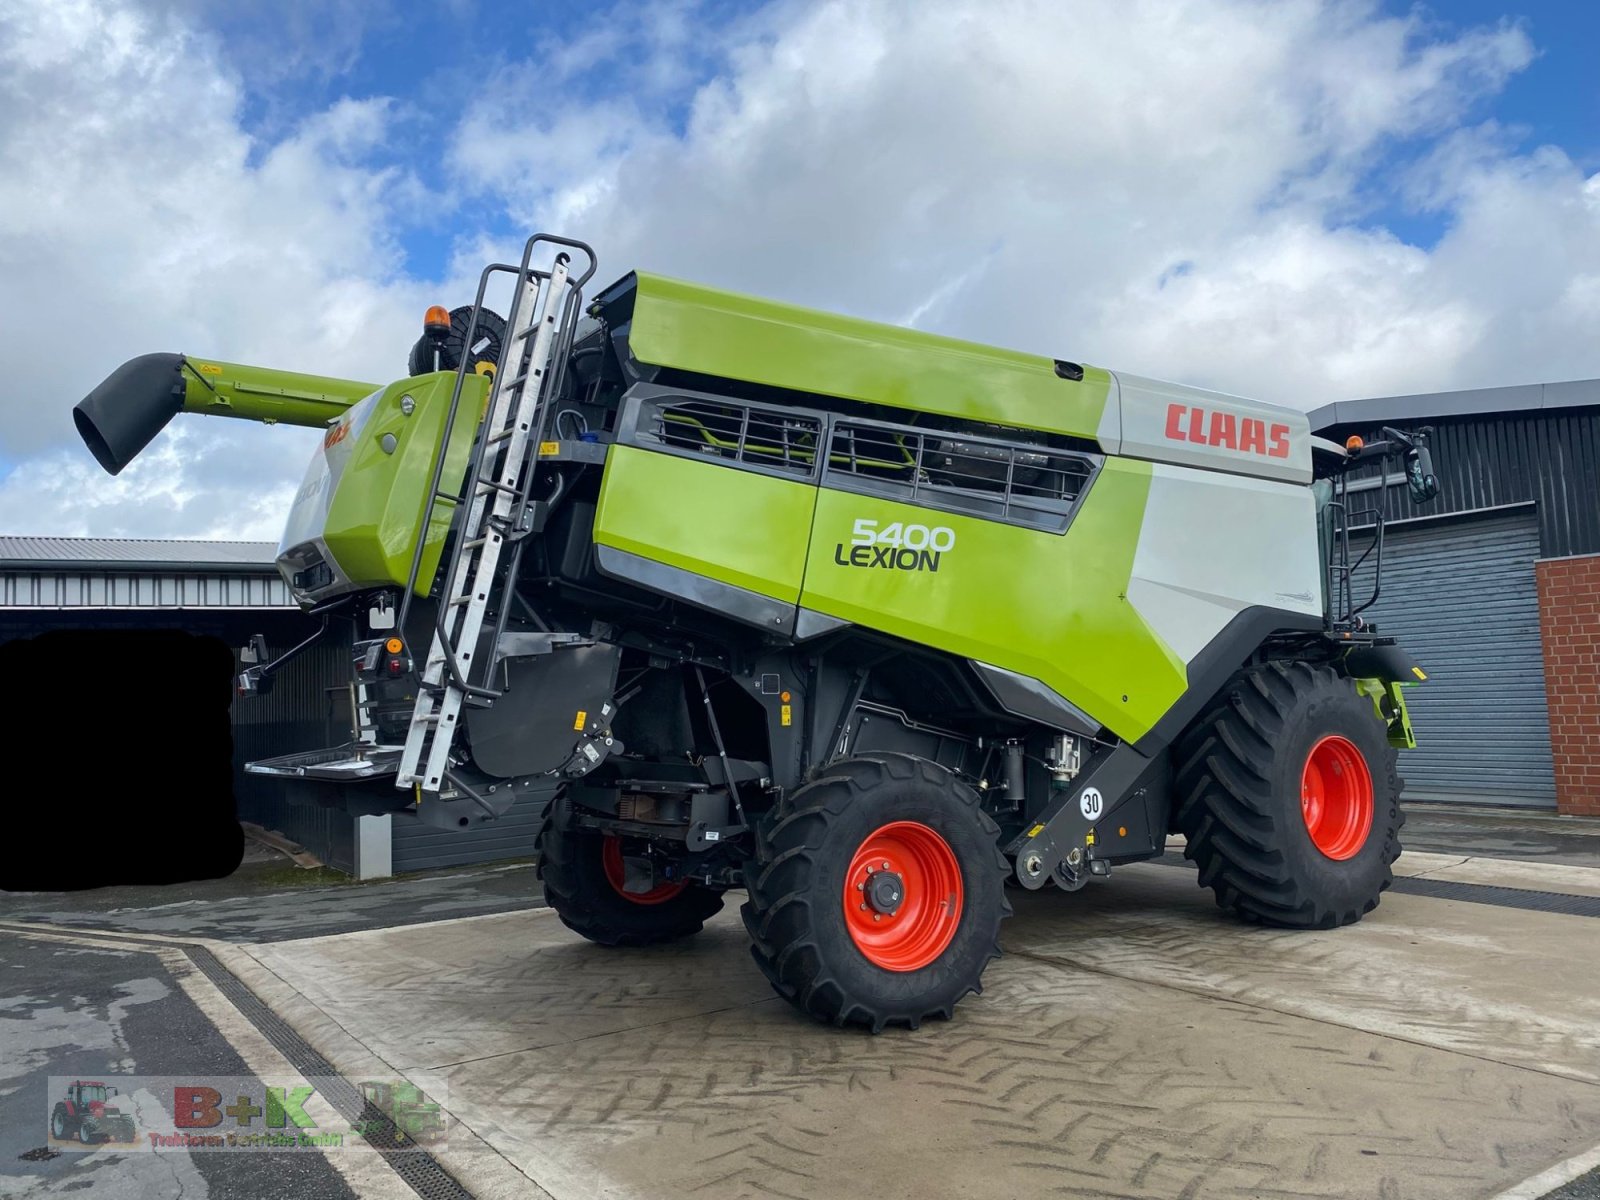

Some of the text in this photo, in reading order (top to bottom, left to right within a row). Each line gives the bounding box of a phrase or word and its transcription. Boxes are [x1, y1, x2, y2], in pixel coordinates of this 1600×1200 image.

[1164, 403, 1290, 459] CLAAS
[851, 518, 956, 552] 5400
[834, 543, 941, 572] LEXION
[1083, 793, 1099, 815] 30
